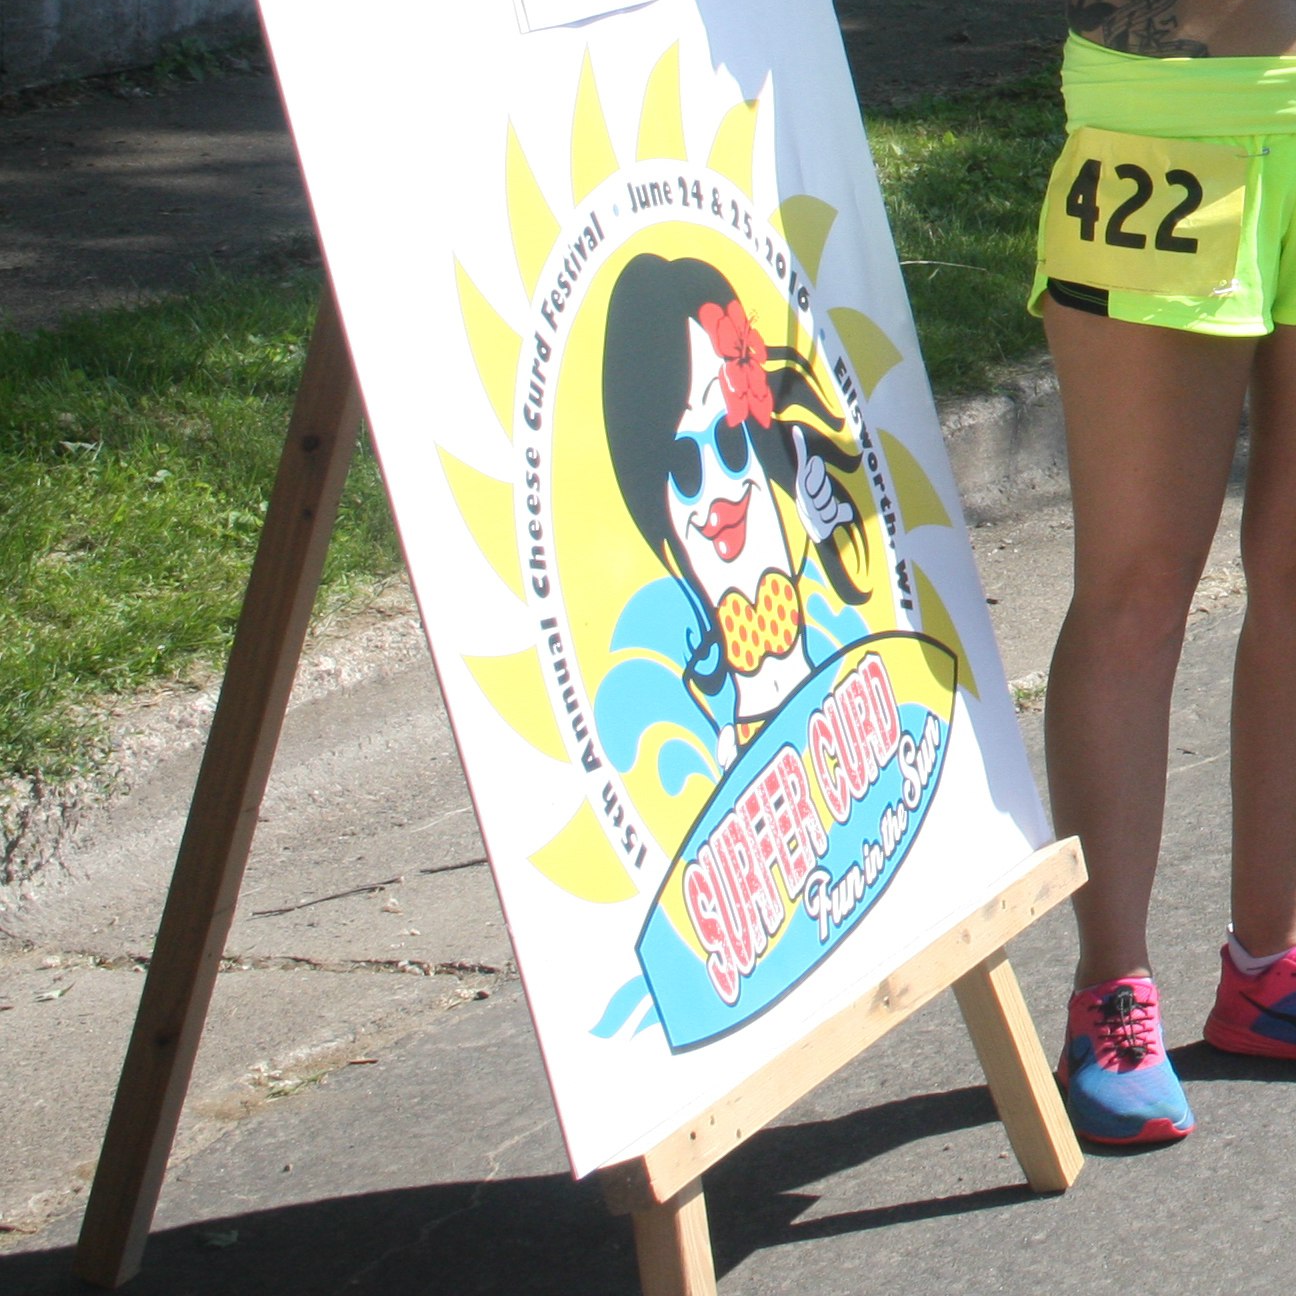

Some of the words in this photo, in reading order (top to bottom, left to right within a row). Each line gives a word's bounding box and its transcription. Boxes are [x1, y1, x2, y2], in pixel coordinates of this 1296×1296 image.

[626, 180, 674, 214] June
[677, 175, 704, 210] 24
[711, 186, 724, 220] &
[731, 199, 759, 253] 25,
[1066, 159, 1203, 254] 422
[540, 210, 605, 333] Festival
[766, 237, 810, 313] 2016
[523, 330, 552, 431] Curd
[525, 447, 551, 599] Cheese
[895, 558, 913, 611] WI
[540, 617, 603, 773] Annual
[602, 780, 648, 870] 15th
[682, 741, 829, 1005] SURFER
[807, 650, 901, 824] CURD
[802, 861, 864, 944] Fun
[862, 838, 884, 888] in
[879, 799, 908, 860] the
[898, 711, 941, 812] Sun
